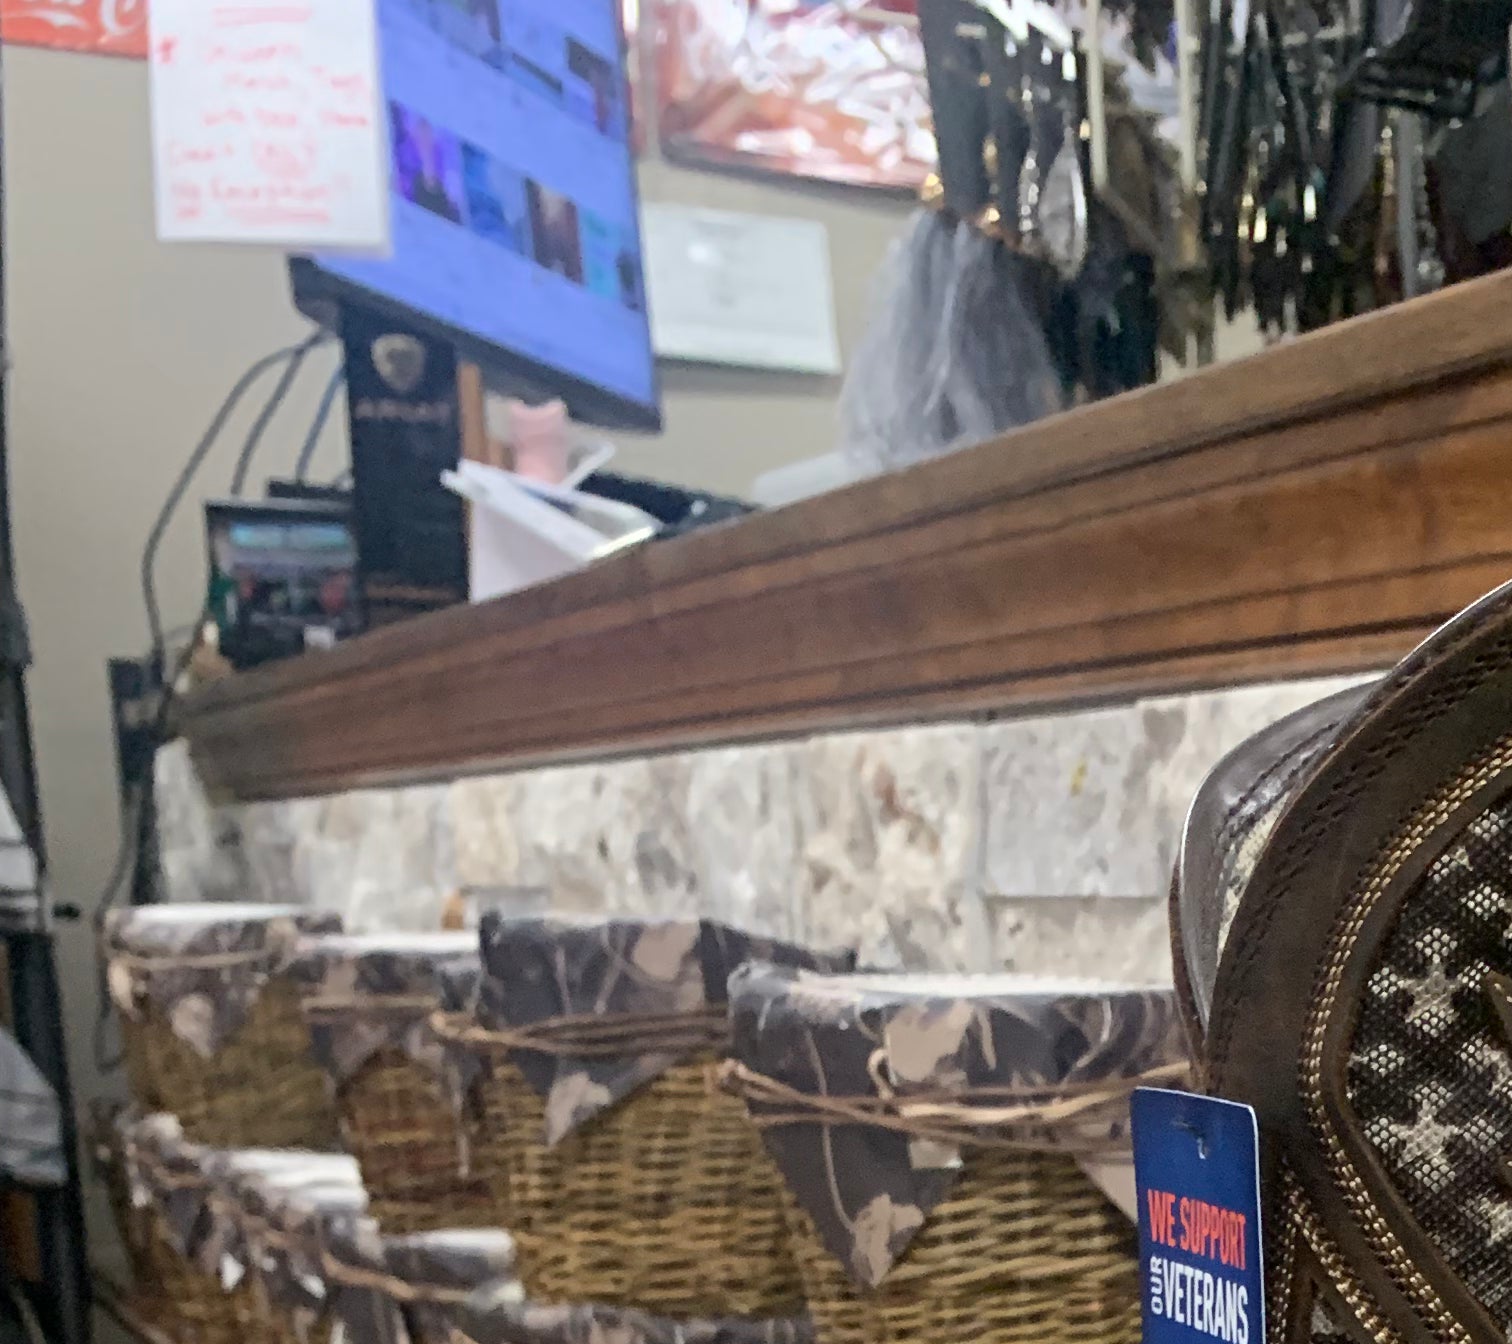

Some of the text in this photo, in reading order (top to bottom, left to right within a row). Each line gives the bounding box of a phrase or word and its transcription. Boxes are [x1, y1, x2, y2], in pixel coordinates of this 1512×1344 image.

[1147, 1189, 1246, 1270] WE SUPPORT
[1150, 1255, 1163, 1315] OUR
